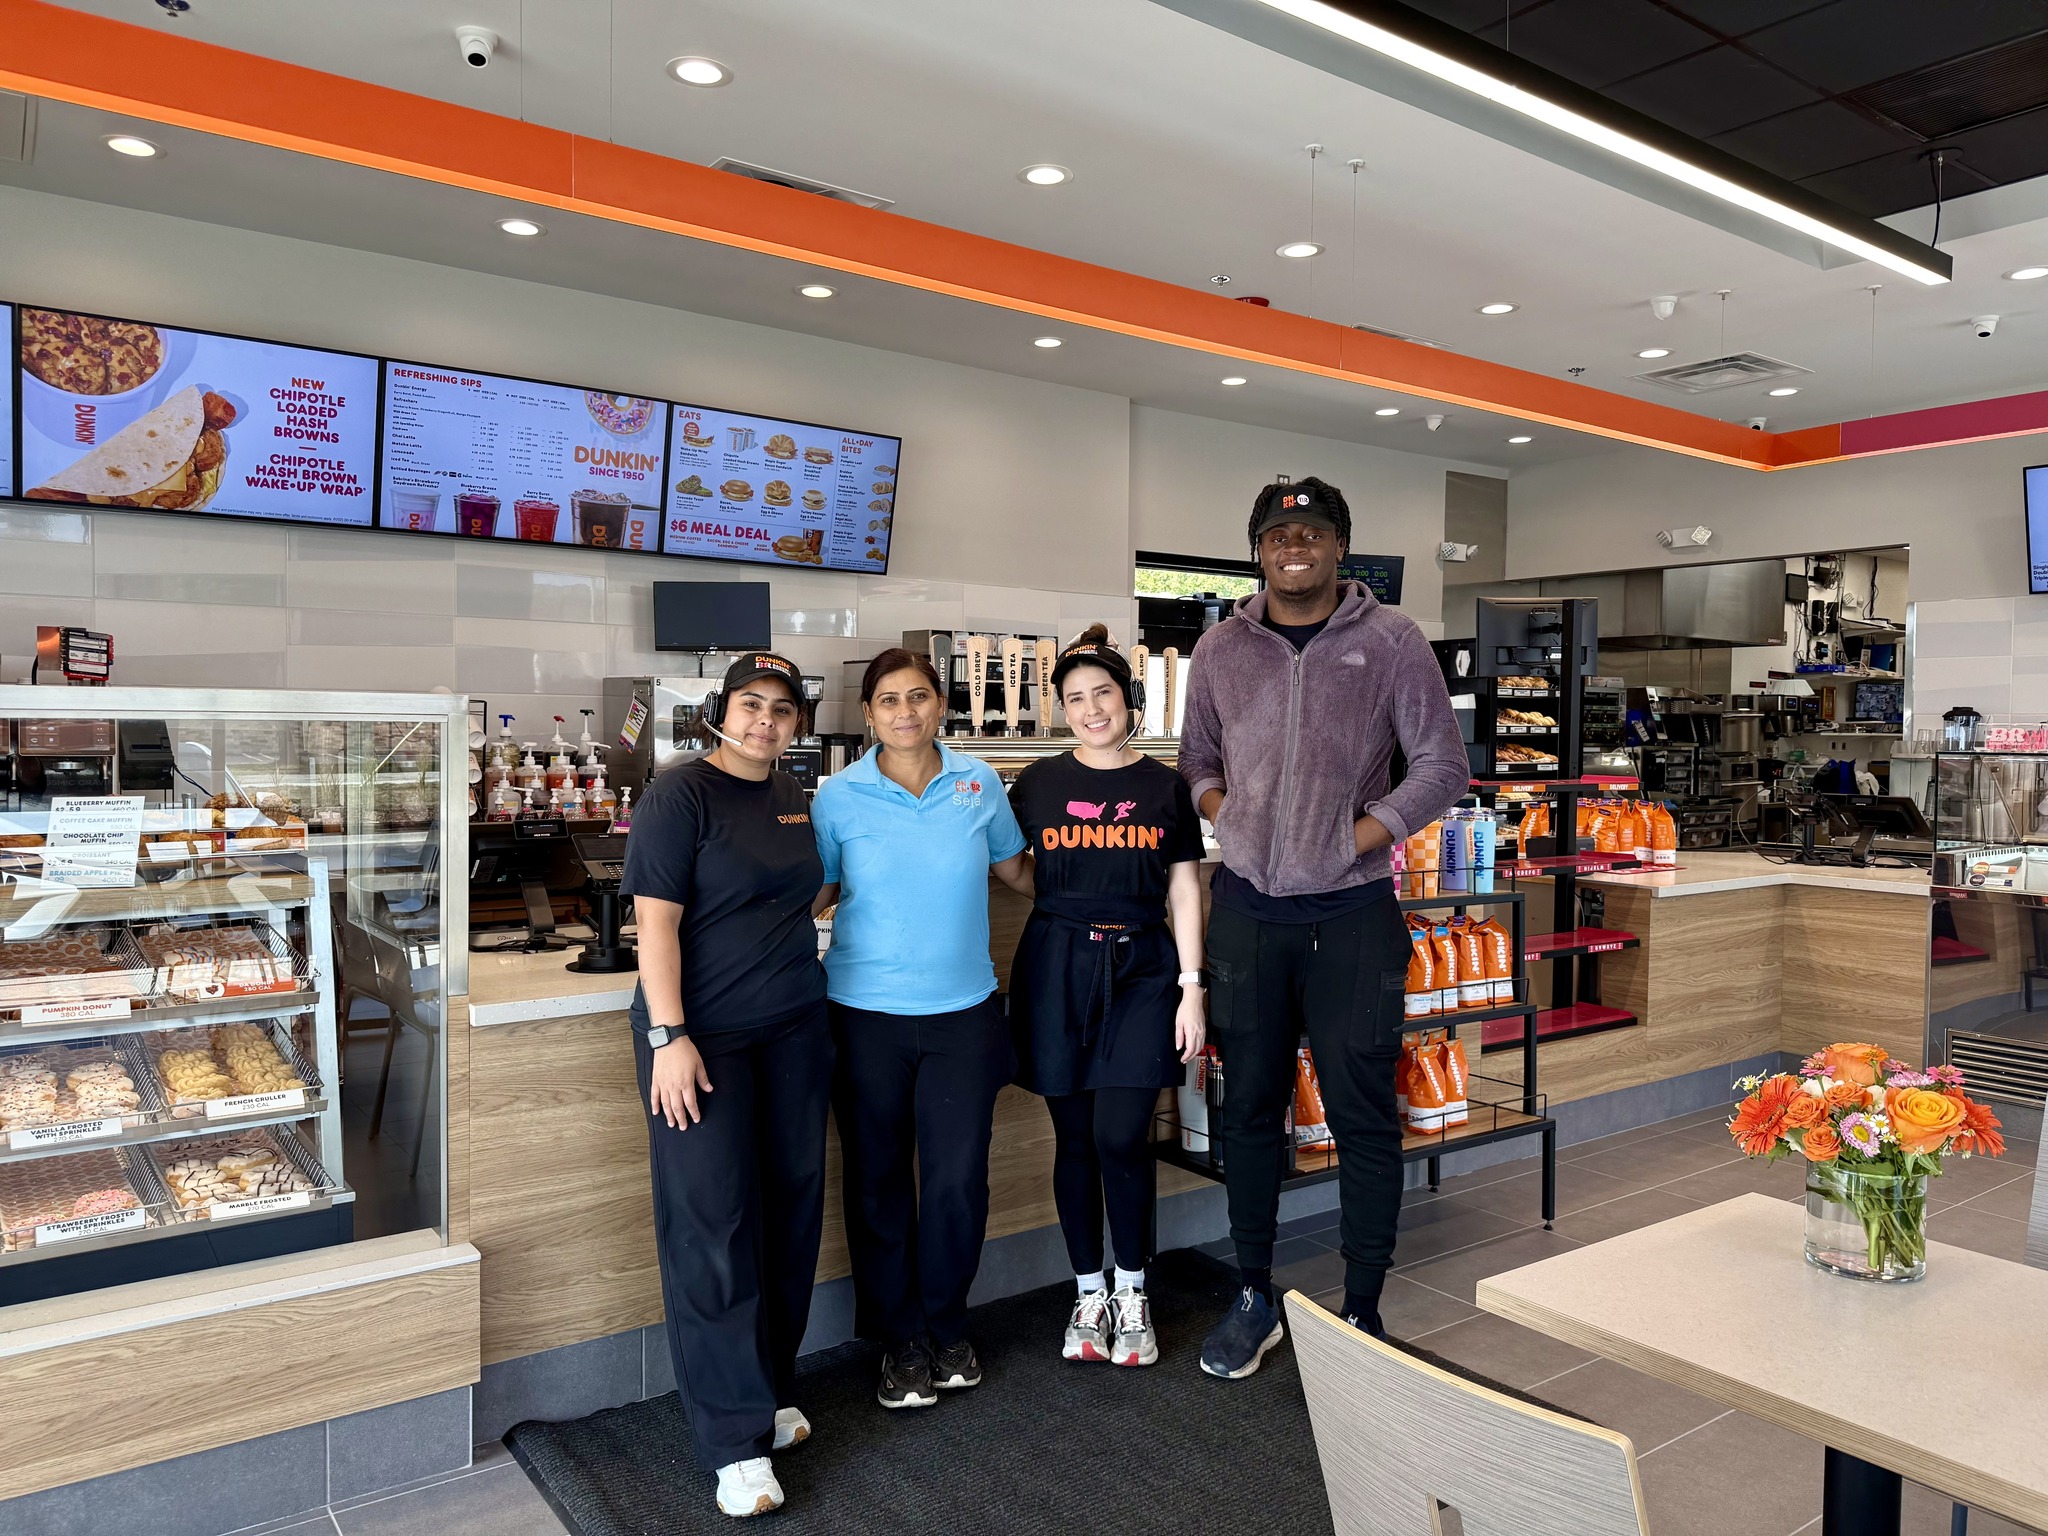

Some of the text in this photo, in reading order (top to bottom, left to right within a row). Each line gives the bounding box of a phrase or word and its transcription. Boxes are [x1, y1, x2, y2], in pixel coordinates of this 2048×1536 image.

[292, 377, 324, 390] NEW
[394, 368, 481, 388] REFRESHING SIPS
[270, 388, 345, 407] CHIPOTLE
[277, 401, 337, 418] LOADED
[679, 410, 701, 420] EATS
[287, 415, 328, 429] HASH
[274, 426, 339, 443] BROWNS
[842, 446, 861, 454] BITES
[270, 454, 345, 471] CHIPOTLE
[574, 445, 660, 473] DUNKIN'
[256, 465, 357, 484] HASH BROWN
[589, 467, 644, 481] SINCE 1950
[671, 519, 771, 541] $6 MEAL DEAL
[756, 656, 791, 669] DUNKIN'
[953, 795, 983, 808] Sejal
[1041, 824, 1165, 851] DUNKIN'
[1418, 945, 1432, 989] DUNKIN'
[1442, 940, 1455, 983] DUNKIN'
[42, 1003, 112, 1014] PUMPKIN DONUT
[1197, 1058, 1207, 1092] DUNKIN'
[1423, 1057, 1444, 1102] DUNKIN'
[1449, 1051, 1463, 1096] DUNKIN'
[255, 1094, 286, 1103] CRULLER
[30, 1121, 103, 1135] VANILLA FROSTED
[59, 1126, 101, 1136] SPRINKLES
[229, 1196, 291, 1209] MARBLE FROSTED
[47, 1211, 135, 1231] STRAWBERRY FROSTED
[83, 1218, 125, 1229] SPRINKLES
